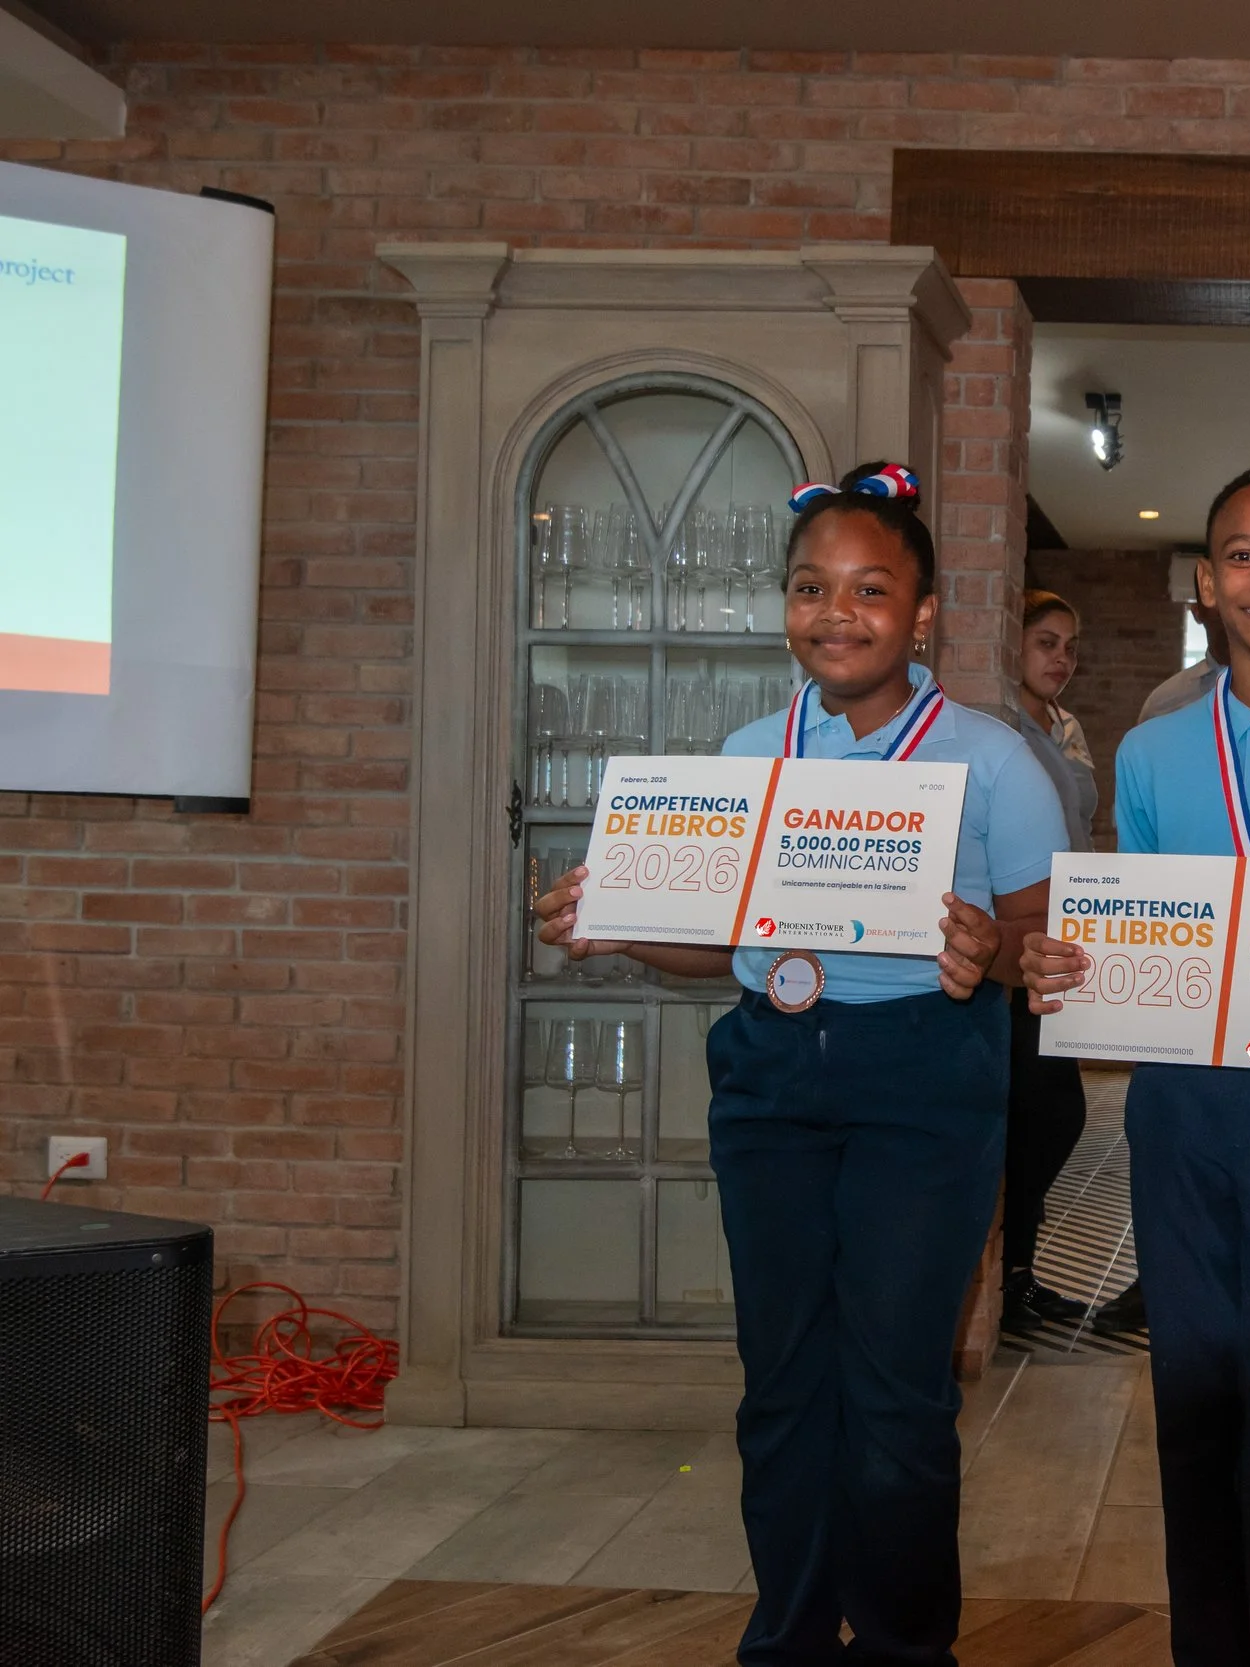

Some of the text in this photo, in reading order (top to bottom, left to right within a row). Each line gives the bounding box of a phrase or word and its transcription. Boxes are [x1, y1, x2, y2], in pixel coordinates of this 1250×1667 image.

[610, 796, 749, 813] COMPETENCIA
[605, 813, 746, 838] DE LIBROS
[784, 808, 925, 833] GANADOR
[781, 835, 922, 854] 5,000.00 PESOS
[600, 843, 740, 893] 2026
[777, 852, 919, 872] DOMINICANOS
[782, 880, 825, 888] Unicamente
[827, 882, 862, 890] canjeable
[1069, 876, 1100, 884] Febrero,
[1063, 898, 1215, 919] COMPETENCIA
[779, 921, 844, 931] PHOENIX TOWER
[866, 929, 928, 940] DREAM project
[1061, 918, 1213, 947] DE LIBROS
[1064, 952, 1212, 1009] 2026
